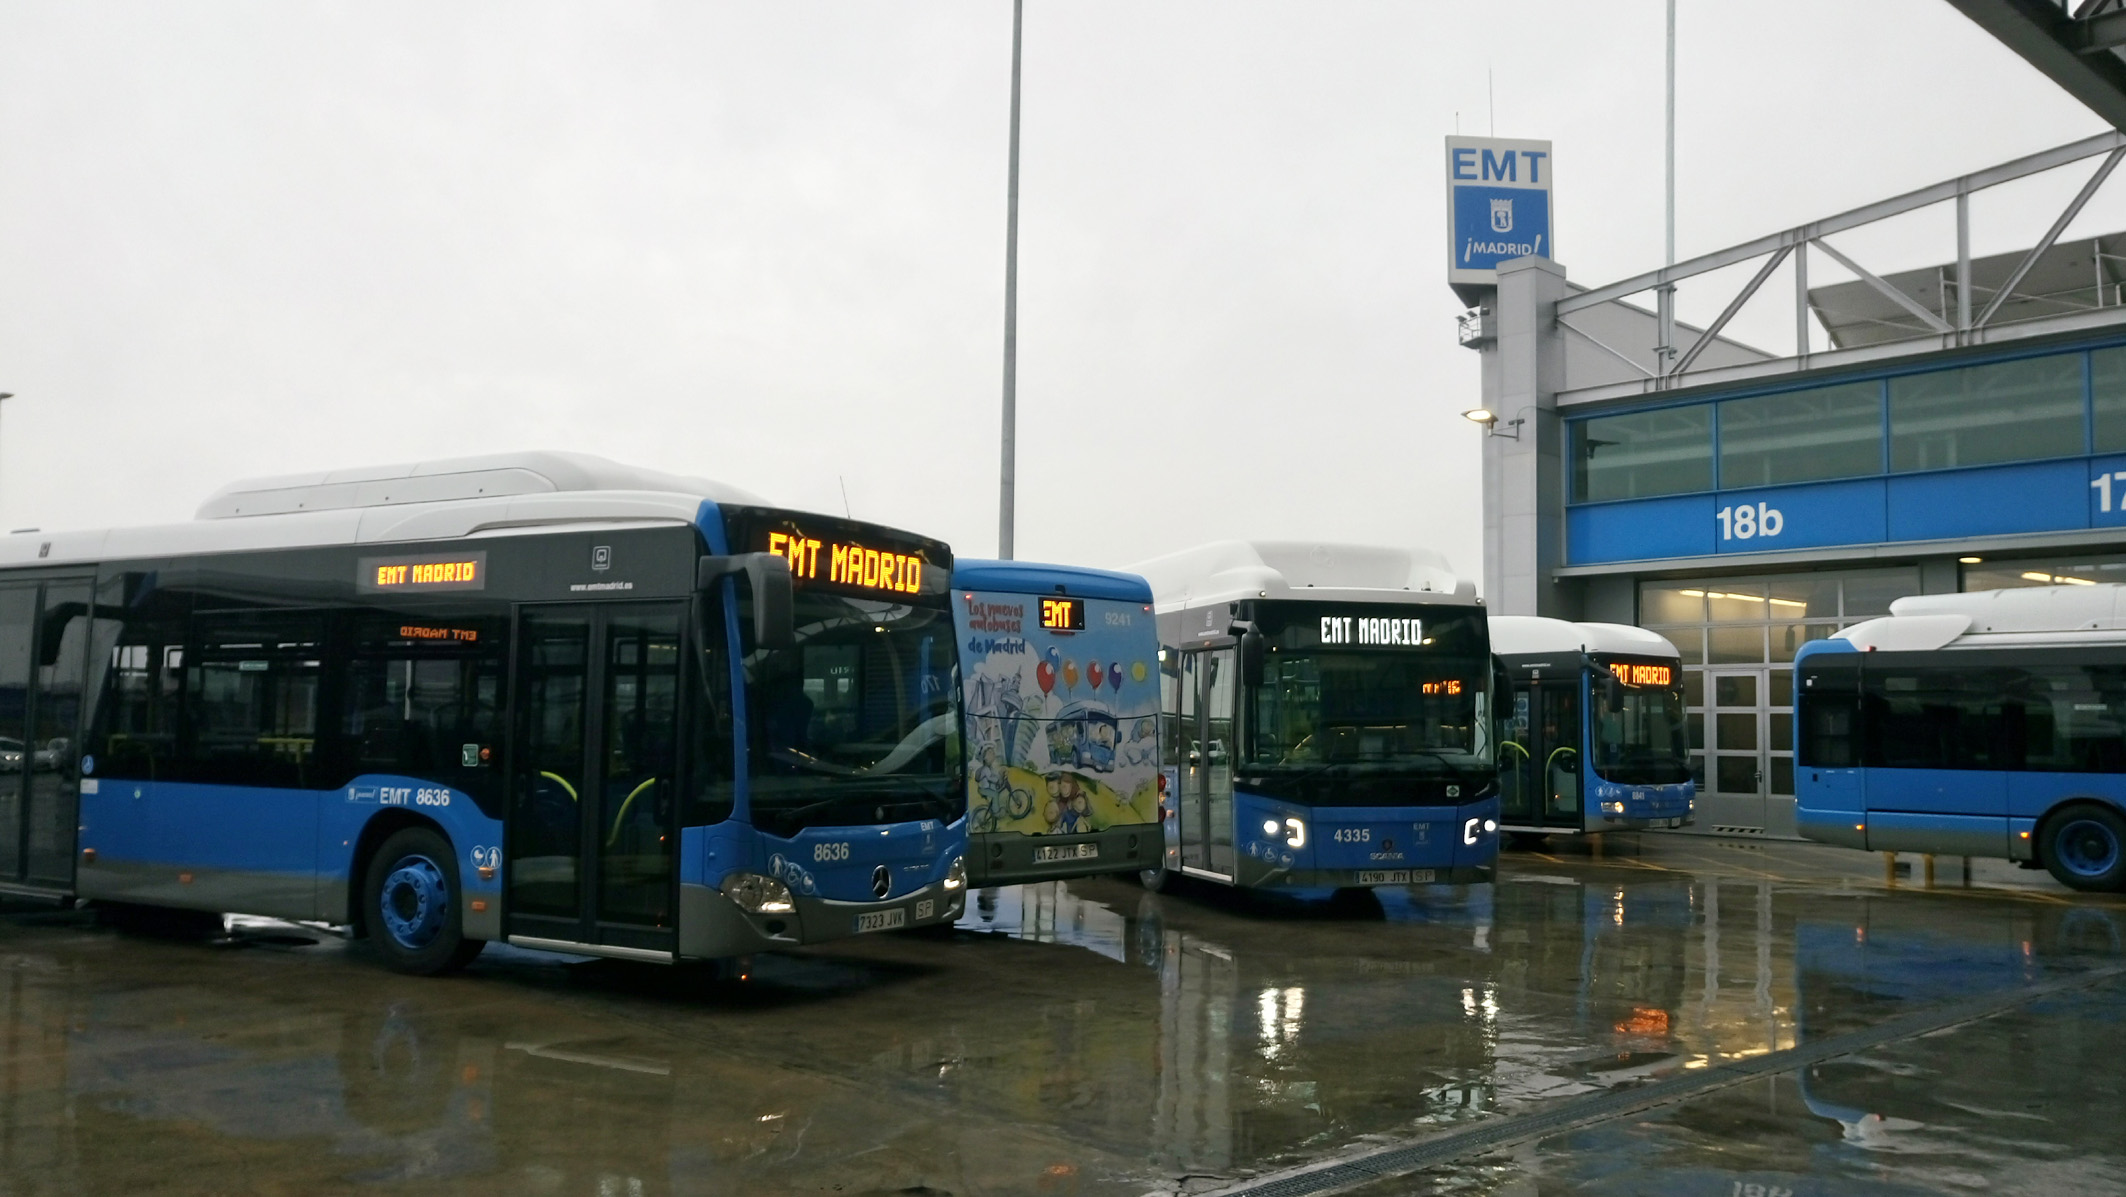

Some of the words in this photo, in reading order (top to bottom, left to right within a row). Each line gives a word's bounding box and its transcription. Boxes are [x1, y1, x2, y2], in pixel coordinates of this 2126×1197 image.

[1452, 147, 1547, 183] EMT
[1464, 234, 1542, 263] ¡MADRID!
[1716, 502, 1784, 540] 18b
[377, 565, 408, 585] EMT
[412, 561, 476, 583] MADRID
[830, 543, 921, 593] MADRID
[968, 600, 986, 617] Los
[987, 604, 1023, 618] nuevos
[1043, 600, 1072, 627] EMT
[969, 616, 1021, 633] autobuses
[1105, 612, 1131, 626] 9241
[1320, 616, 1351, 644] EMT
[1358, 617, 1421, 645] MADRID
[968, 636, 983, 653] de
[984, 638, 1026, 655] Madrid
[1632, 665, 1670, 685] MADRID
[380, 787, 411, 805] EMT
[416, 788, 450, 806] 8636
[920, 821, 934, 831] EMT
[1334, 829, 1370, 842] 4335
[814, 842, 849, 862] 8636
[1036, 849, 1058, 860] 4122
[1062, 847, 1078, 858] JTX
[1080, 845, 1095, 856] SP
[1361, 872, 1385, 882] 4190
[1390, 872, 1407, 882] JTX
[1415, 871, 1432, 880] SP
[917, 902, 932, 917] SP
[859, 914, 884, 930] 7323
[887, 911, 904, 927] JVK
